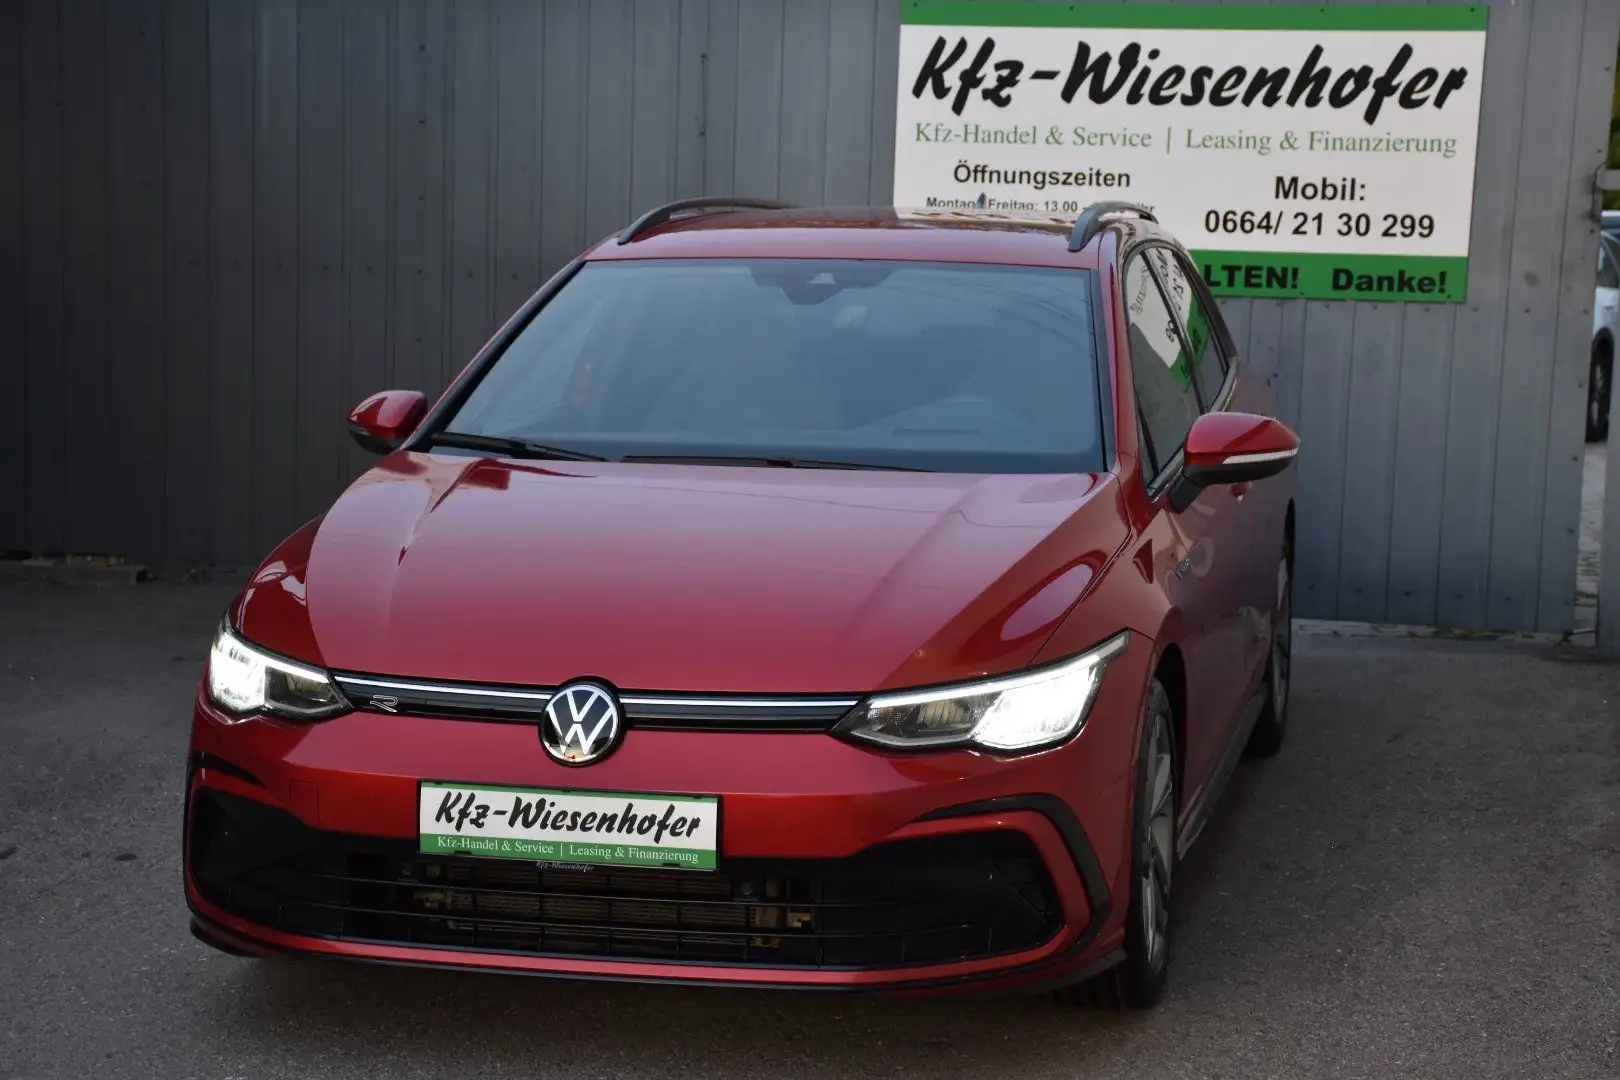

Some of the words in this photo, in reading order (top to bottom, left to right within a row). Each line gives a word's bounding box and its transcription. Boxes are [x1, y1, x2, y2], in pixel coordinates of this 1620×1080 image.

[911, 35, 1468, 125] Kfz-Wiesenhofer
[915, 122, 1038, 145] Kfz-Handel
[1045, 127, 1065, 146] &
[1072, 126, 1153, 148] Service
[1185, 128, 1271, 155] Leasing
[1279, 130, 1300, 151] &
[1308, 130, 1458, 159] Finanzierung
[953, 159, 1131, 190] Öffnungszeiten
[1274, 175, 1367, 202] Mobil:
[1204, 209, 1284, 235] 0664/
[1291, 211, 1324, 236] 21
[1336, 212, 1371, 237] 30
[1381, 213, 1435, 239] 299
[1331, 267, 1448, 294] Danke!
[435, 790, 701, 844] Kfz-Wiesenhofer
[437, 836, 498, 851] Kfz-Handel
[501, 840, 512, 852] &
[514, 840, 554, 854] Service
[569, 844, 612, 859] Leasing
[614, 846, 625, 858] &
[628, 847, 699, 864] Finanzierung
